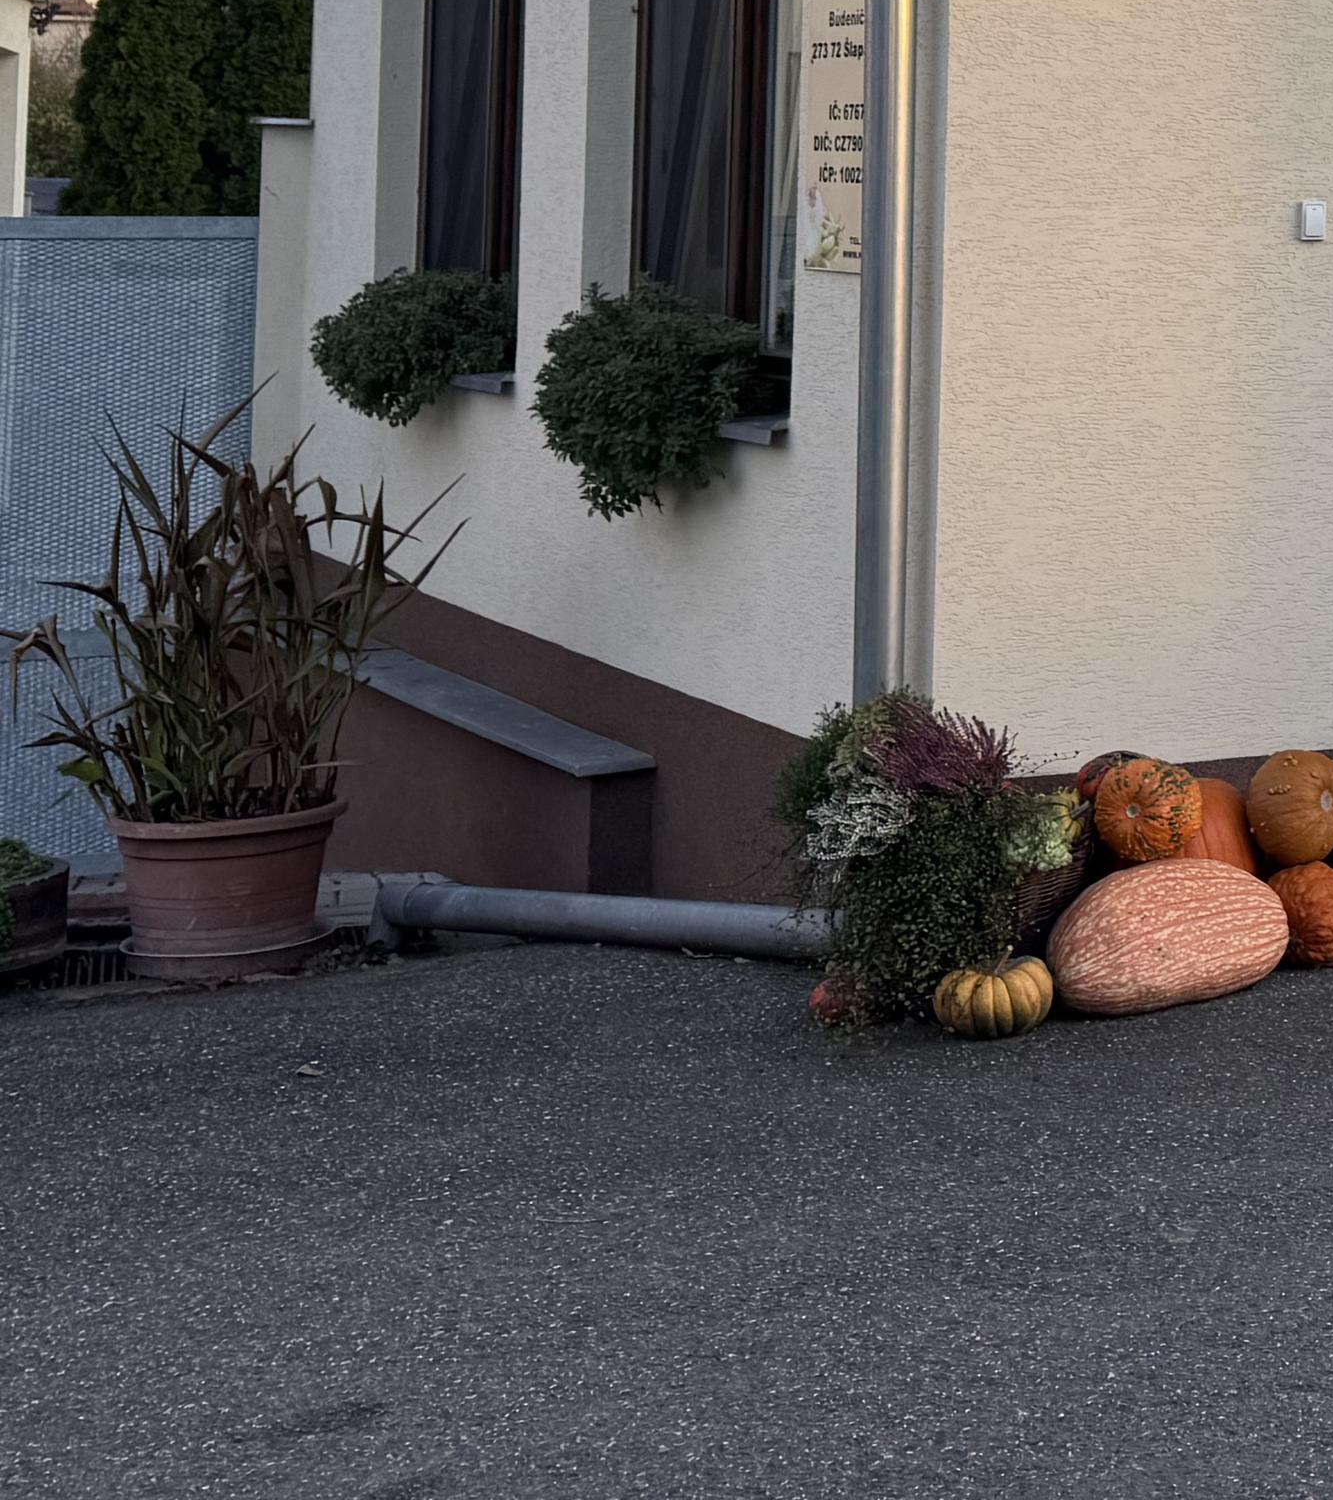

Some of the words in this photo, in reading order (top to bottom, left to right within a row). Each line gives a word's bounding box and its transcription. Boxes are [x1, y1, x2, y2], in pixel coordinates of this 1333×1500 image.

[811, 42, 828, 59] 273
[830, 41, 841, 58] 72
[829, 100, 841, 121] IČ:
[813, 131, 833, 152] DIČ:
[818, 162, 838, 183] IČP:
